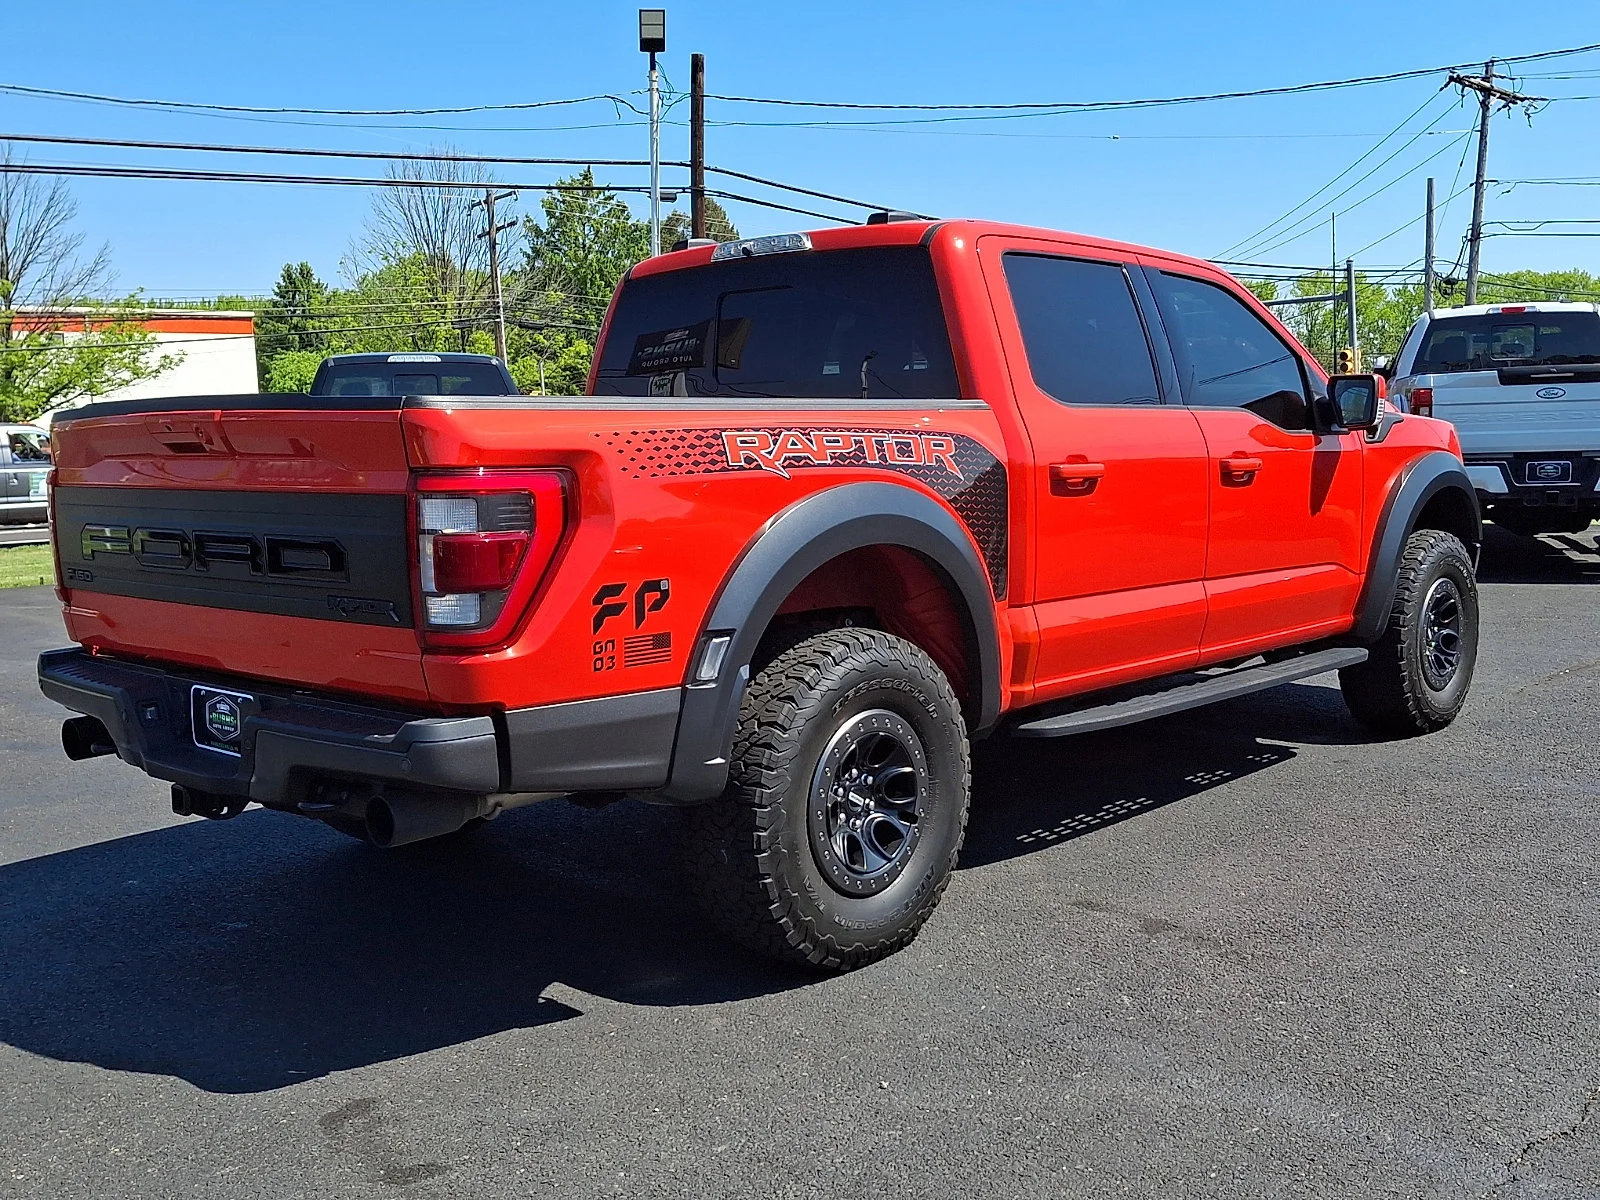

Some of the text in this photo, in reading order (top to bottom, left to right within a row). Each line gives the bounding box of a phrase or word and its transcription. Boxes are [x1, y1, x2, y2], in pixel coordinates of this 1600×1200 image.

[721, 431, 965, 480] RAPTOR
[81, 523, 349, 583] FORD
[591, 577, 672, 636] FP
